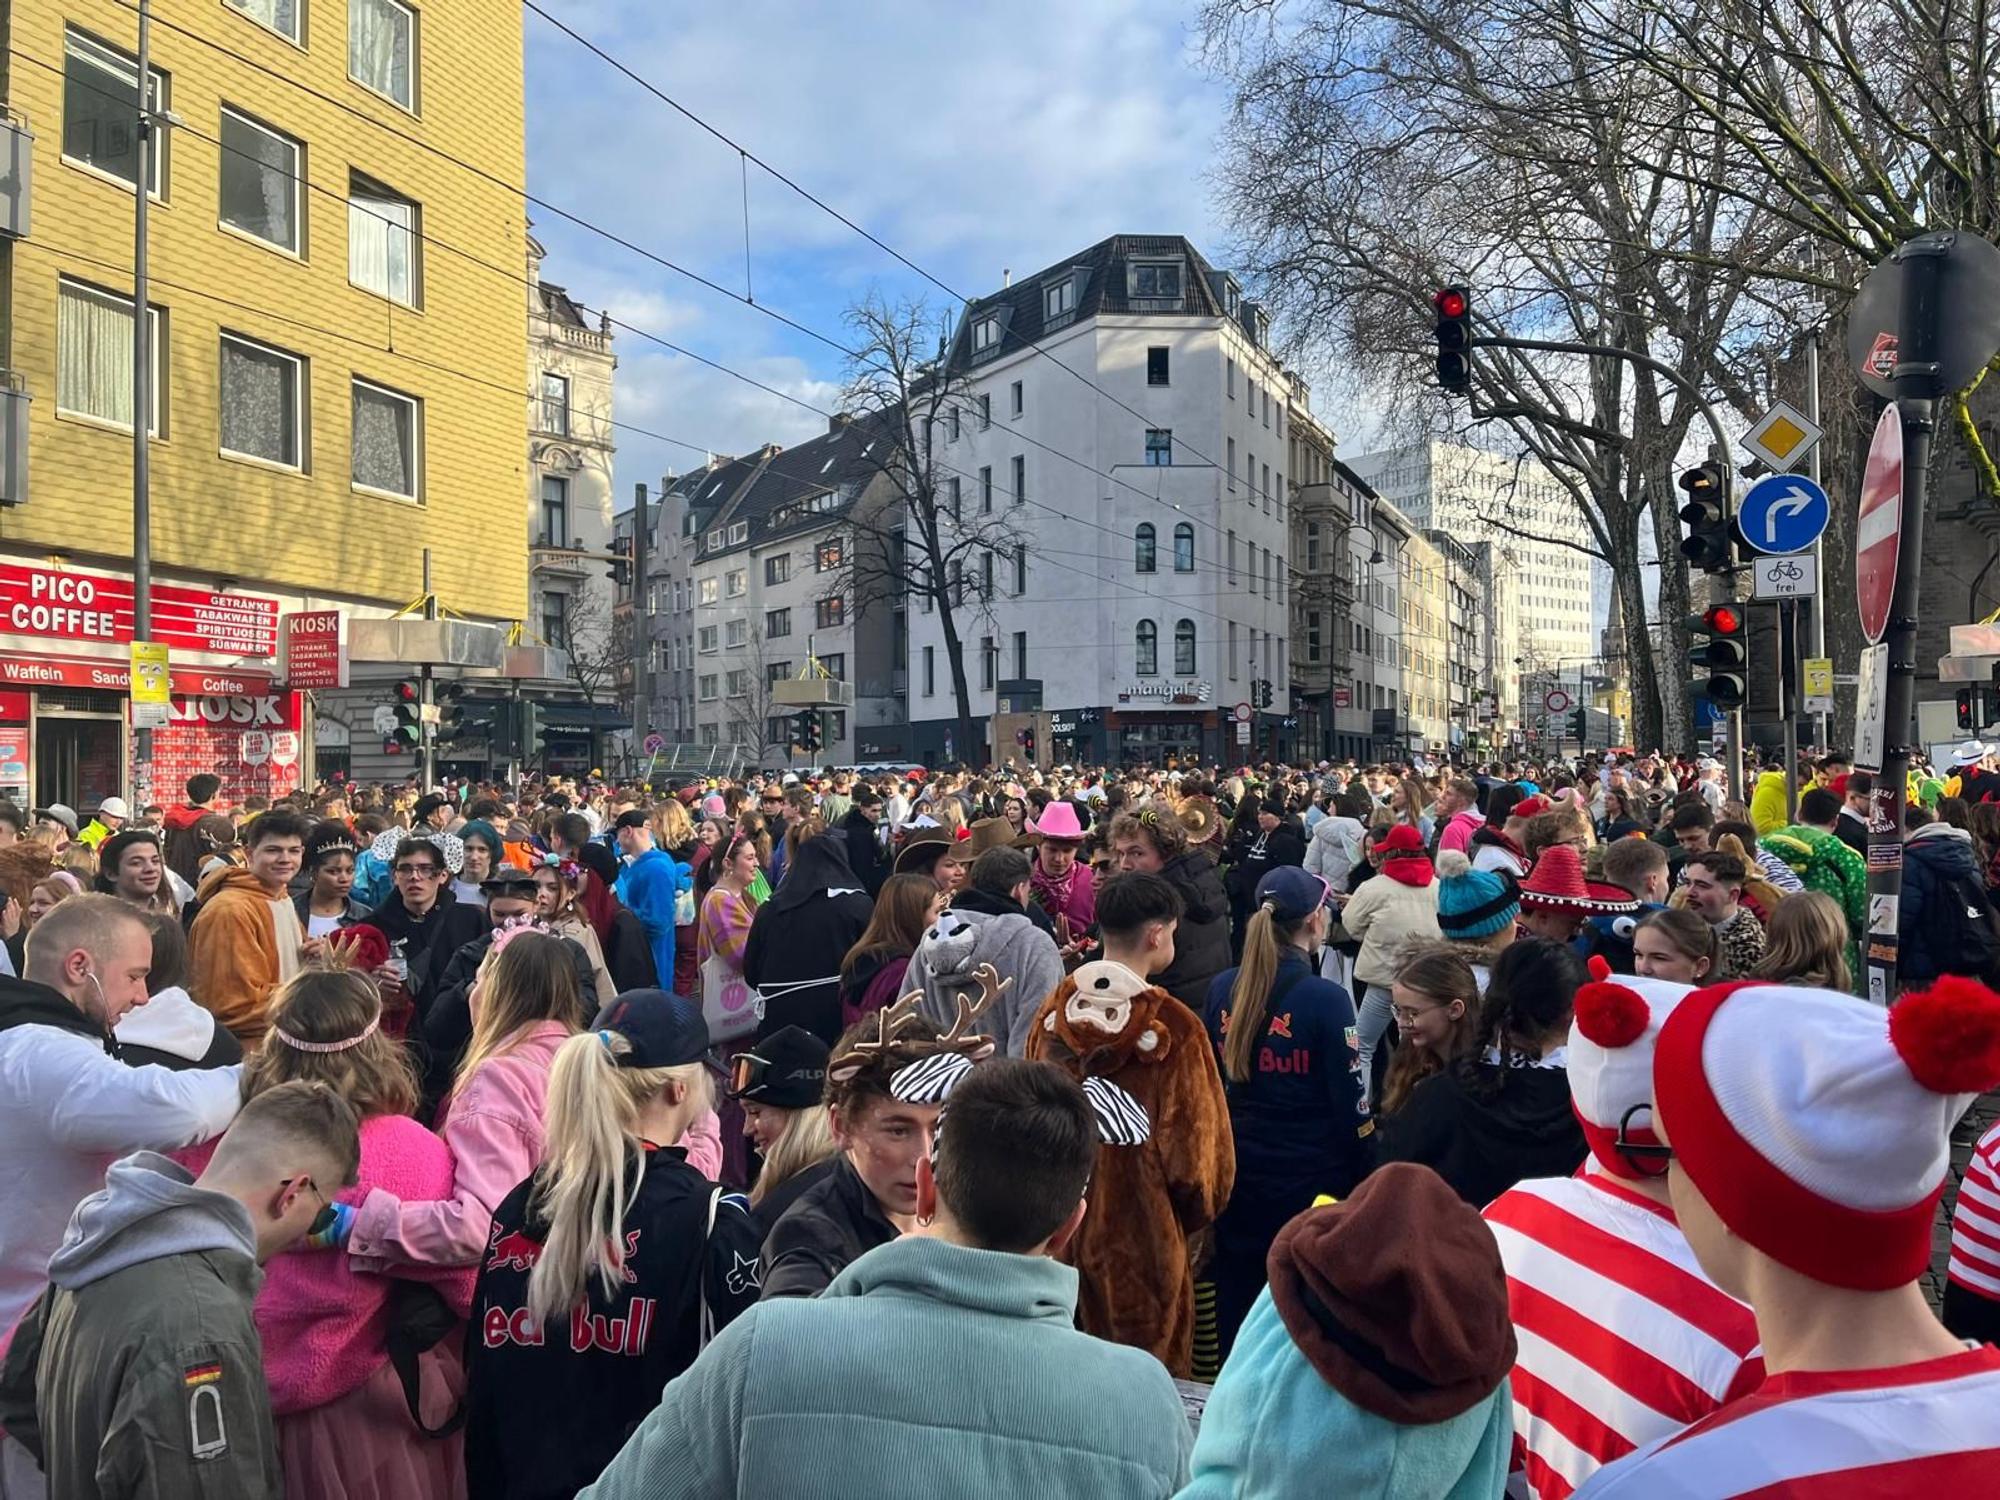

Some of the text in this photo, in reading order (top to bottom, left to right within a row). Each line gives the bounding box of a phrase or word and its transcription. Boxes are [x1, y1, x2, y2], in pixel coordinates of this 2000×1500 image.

[31, 574, 94, 604] PICO
[1776, 582, 1796, 592] frei
[210, 596, 271, 612] GETRÄNKE
[11, 603, 114, 637] COFFEE
[193, 609, 271, 626] TABAKWAREN
[290, 616, 337, 634] KIOSK
[195, 624, 270, 640] SPIRITUOSEN
[3, 663, 244, 693] Waffeln Sands Coffee
[168, 694, 284, 724] IOSK
[1259, 1046, 1310, 1074] Bull
[785, 1067, 825, 1080] ALP
[484, 1305, 545, 1348] ed
